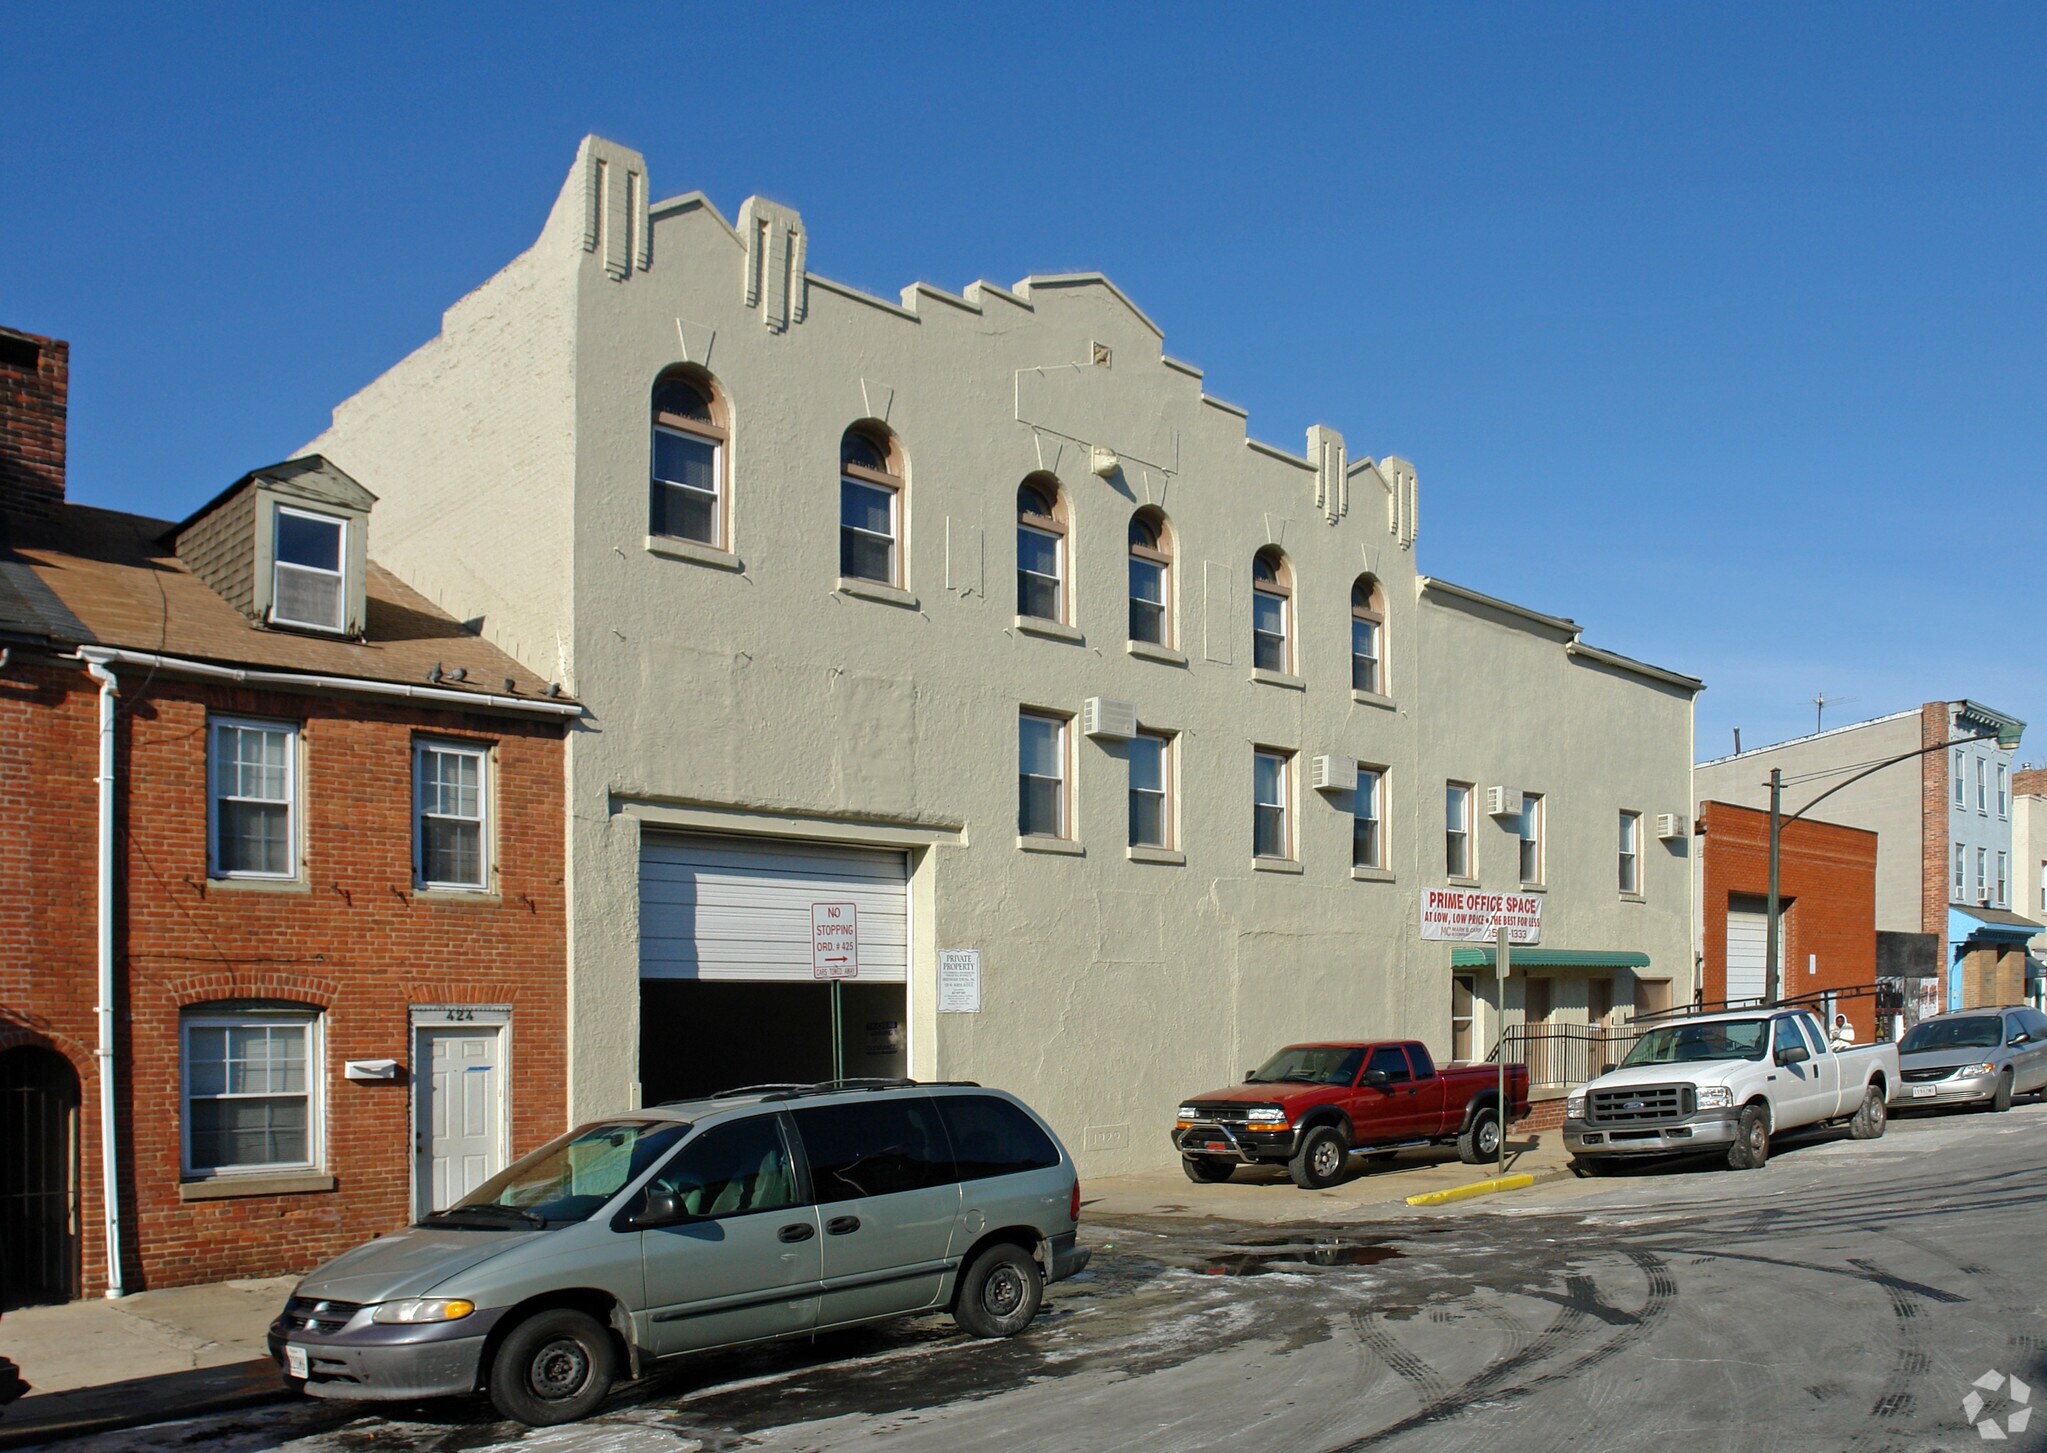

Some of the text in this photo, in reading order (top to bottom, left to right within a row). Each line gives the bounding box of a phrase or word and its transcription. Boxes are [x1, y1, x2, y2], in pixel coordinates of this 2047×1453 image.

[1429, 891, 1536, 914] PRIME OFFICE SPACE
[827, 907, 841, 918] NO
[1424, 911, 1433, 922] AT
[1452, 912, 1467, 924] LOW
[1468, 913, 1485, 925] PRICE
[1490, 915, 1502, 926] THE
[1503, 915, 1517, 926] BEST
[1517, 916, 1528, 927] FOR
[1528, 917, 1540, 928] LESS
[816, 924, 854, 936] STOPPING
[816, 942, 835, 952] ORD.
[946, 954, 972, 963] PRIVATE
[943, 962, 975, 971] PROPERTY
[446, 1009, 474, 1021] 424
